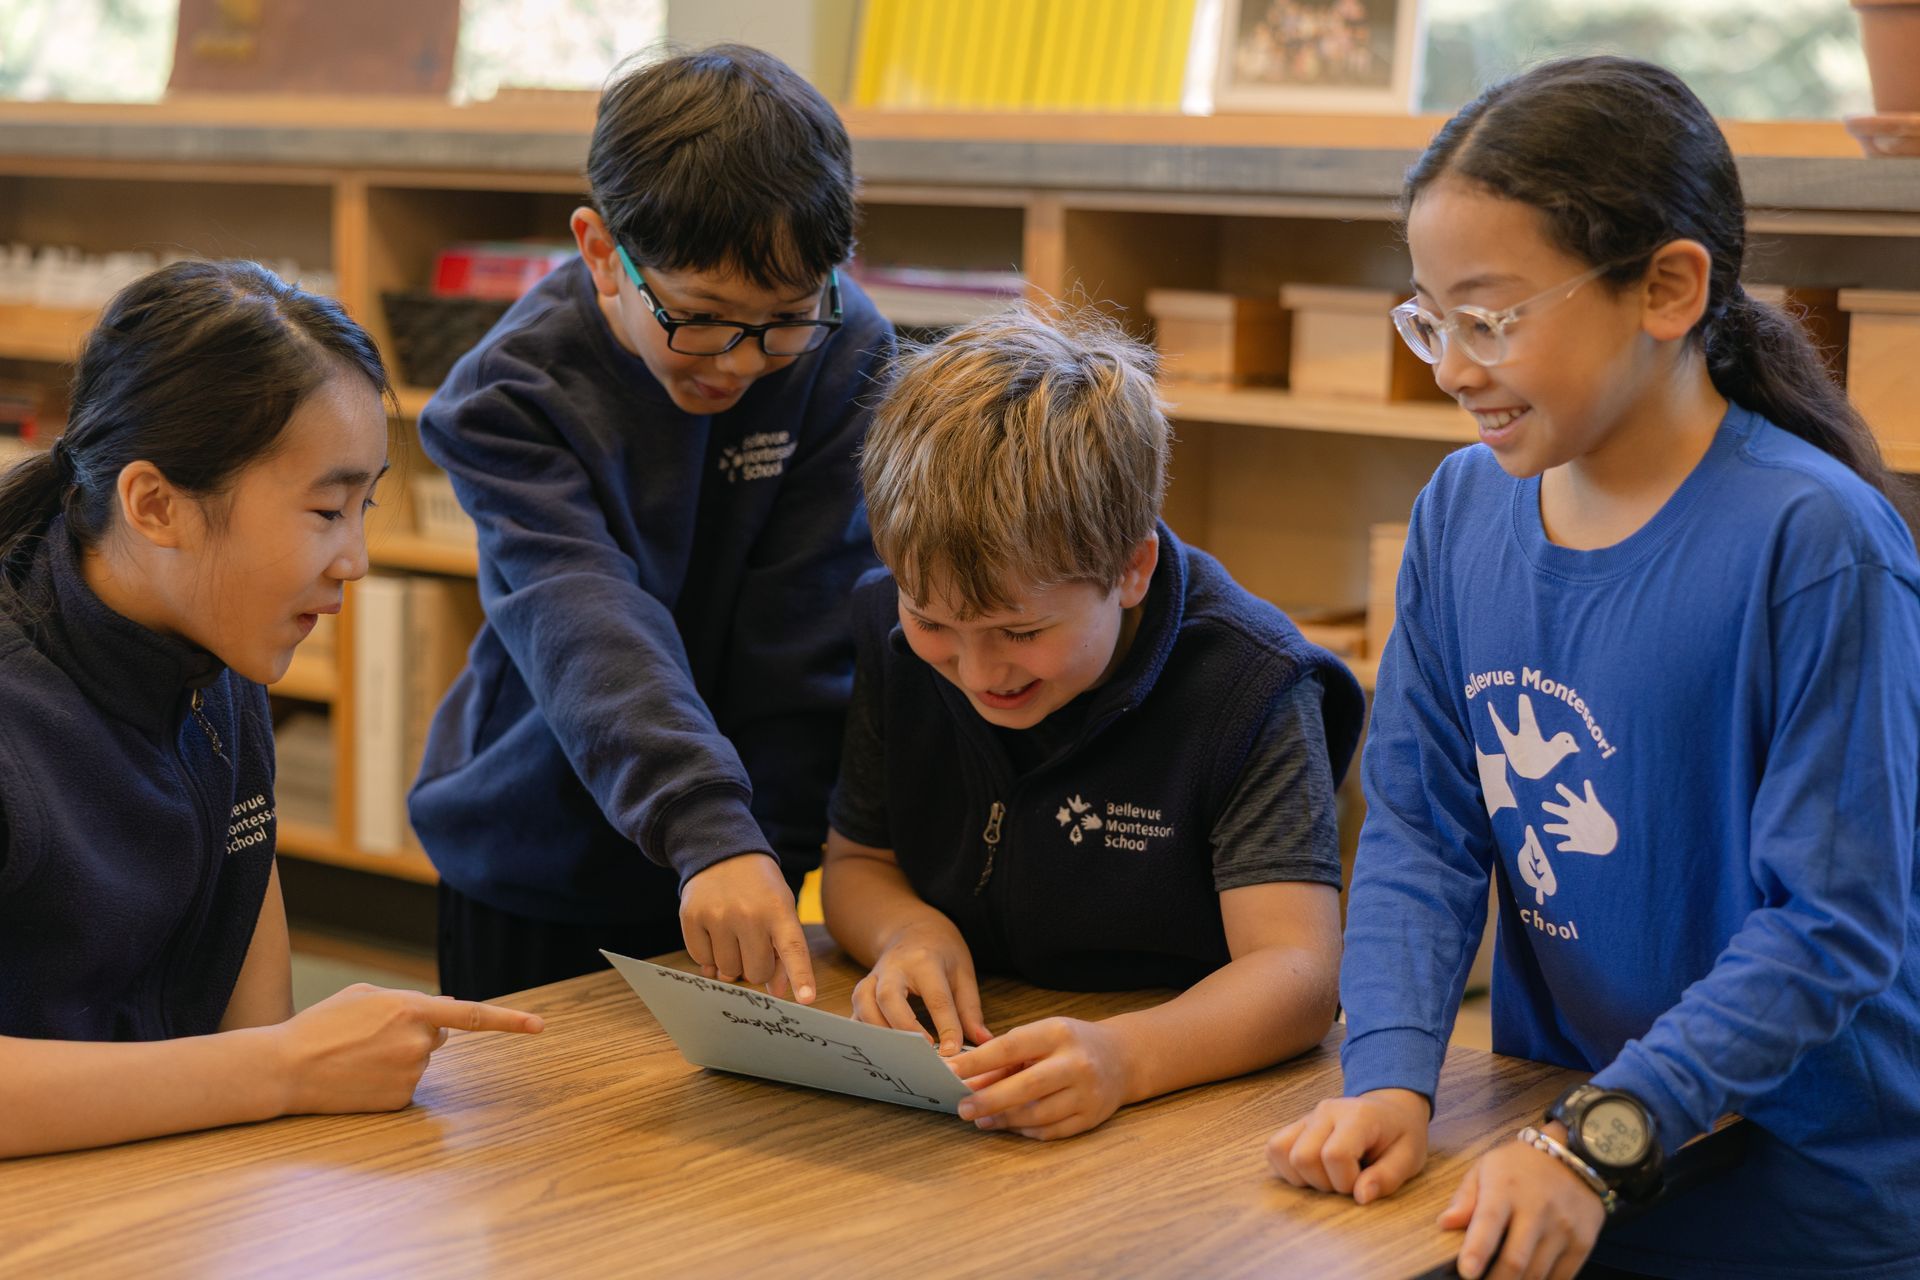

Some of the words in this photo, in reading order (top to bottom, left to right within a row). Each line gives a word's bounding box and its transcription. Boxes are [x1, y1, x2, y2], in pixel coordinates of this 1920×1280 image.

[1465, 671, 1515, 699] ellevue
[1521, 666, 1617, 760] Montessori
[227, 808, 275, 837] ontess
[230, 794, 266, 818] evue
[1106, 802, 1162, 821] Bellevue
[1519, 908, 1579, 940] chool
[656, 968, 783, 1014] Yellowstone
[722, 1010, 882, 1069] Ecosystems
[863, 1067, 940, 1104] The
